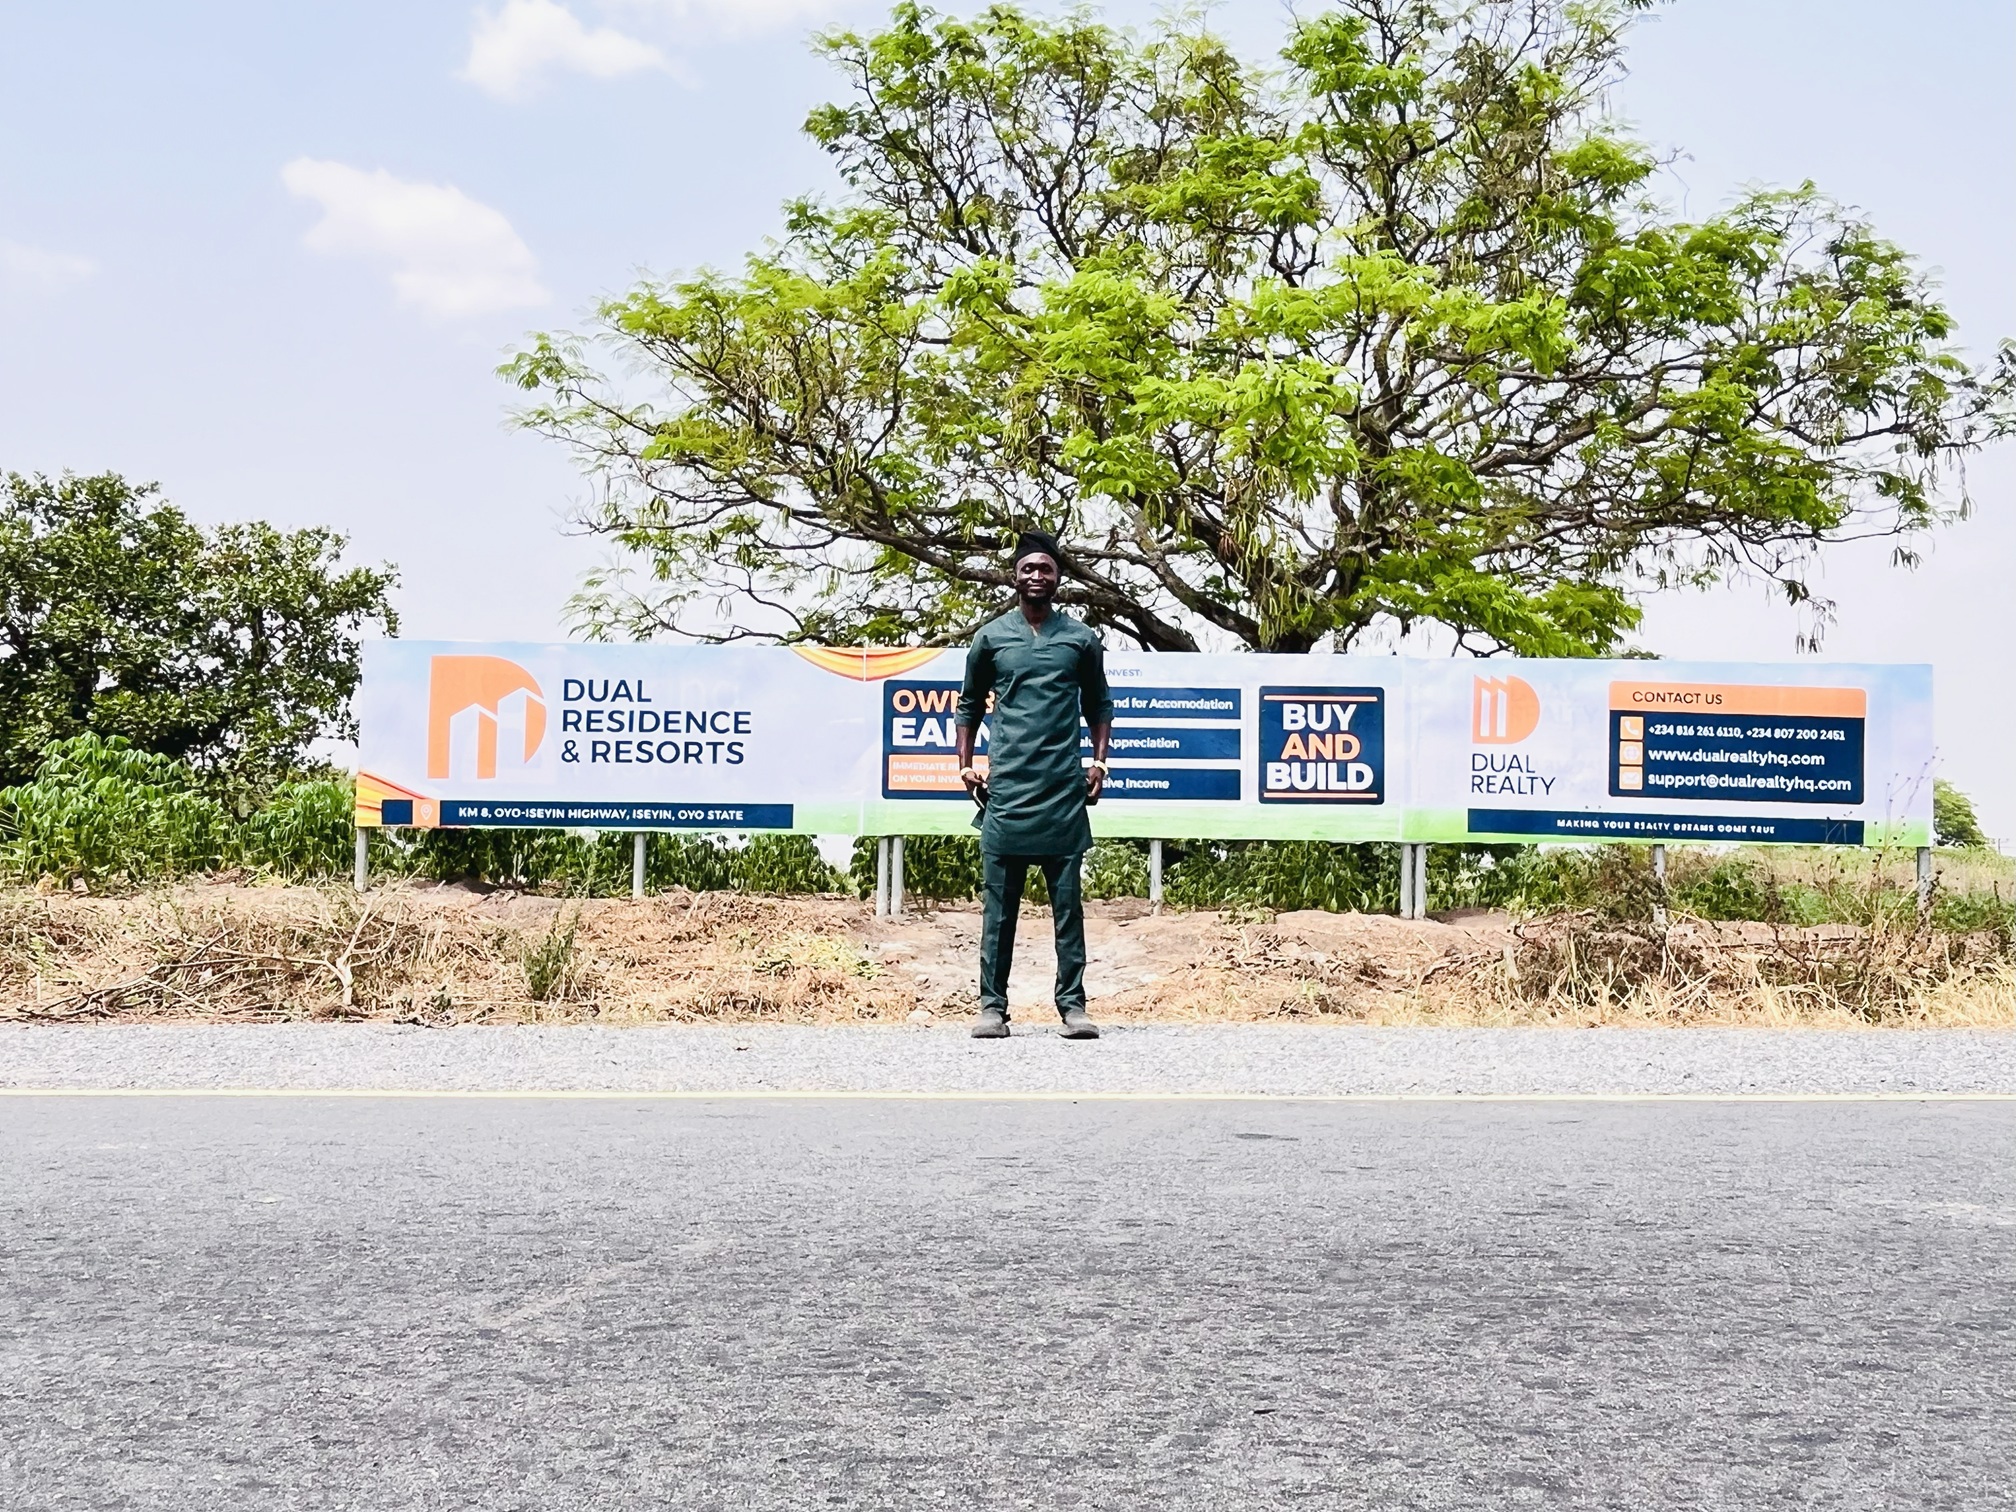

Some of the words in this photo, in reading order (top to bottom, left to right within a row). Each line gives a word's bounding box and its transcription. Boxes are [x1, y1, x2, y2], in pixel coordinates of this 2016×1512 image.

[563, 679, 652, 702] DUAL
[1632, 691, 1701, 704] CONTACT
[1705, 693, 1723, 705] US
[1131, 697, 1148, 709] for
[1149, 698, 1234, 710] Accomodation
[562, 709, 752, 734] RESIDENCE
[1282, 703, 1358, 731] BUY
[1648, 724, 1674, 735] +234
[1676, 725, 1695, 736] 816
[1696, 726, 1715, 737] 261
[1716, 726, 1744, 739] 6110,
[1746, 728, 1773, 739] +234
[1774, 728, 1795, 739] 807
[1796, 729, 1819, 740] 200
[1820, 729, 1846, 741] 2451
[561, 739, 581, 763] &
[591, 740, 745, 765] RESORTS
[1280, 733, 1361, 760] AND
[892, 761, 947, 771] IMMEDIATE
[1471, 753, 1536, 773] DUAL
[1648, 748, 1826, 767] www.dualrealtyhq.com
[892, 774, 908, 783] ON
[909, 774, 936, 784] YOUR
[1125, 777, 1170, 790] Income
[1266, 762, 1374, 790] BUILD
[1471, 775, 1556, 795] REALTY
[1648, 773, 1852, 792] support@dualrealtyhq.com
[459, 807, 478, 818] KM
[481, 807, 492, 818] 8,
[494, 807, 565, 819] OYO-ISEYIN
[568, 808, 630, 821] HIGHWAY,
[633, 808, 676, 821] ISEYIN,
[678, 809, 704, 820] OYO
[707, 809, 744, 821] STATE
[1557, 819, 1600, 828] MAKING
[1602, 820, 1631, 830] YOUR
[1673, 823, 1714, 832] DREAMS
[1717, 824, 1747, 833] COME
[1750, 825, 1775, 834] TRUE
